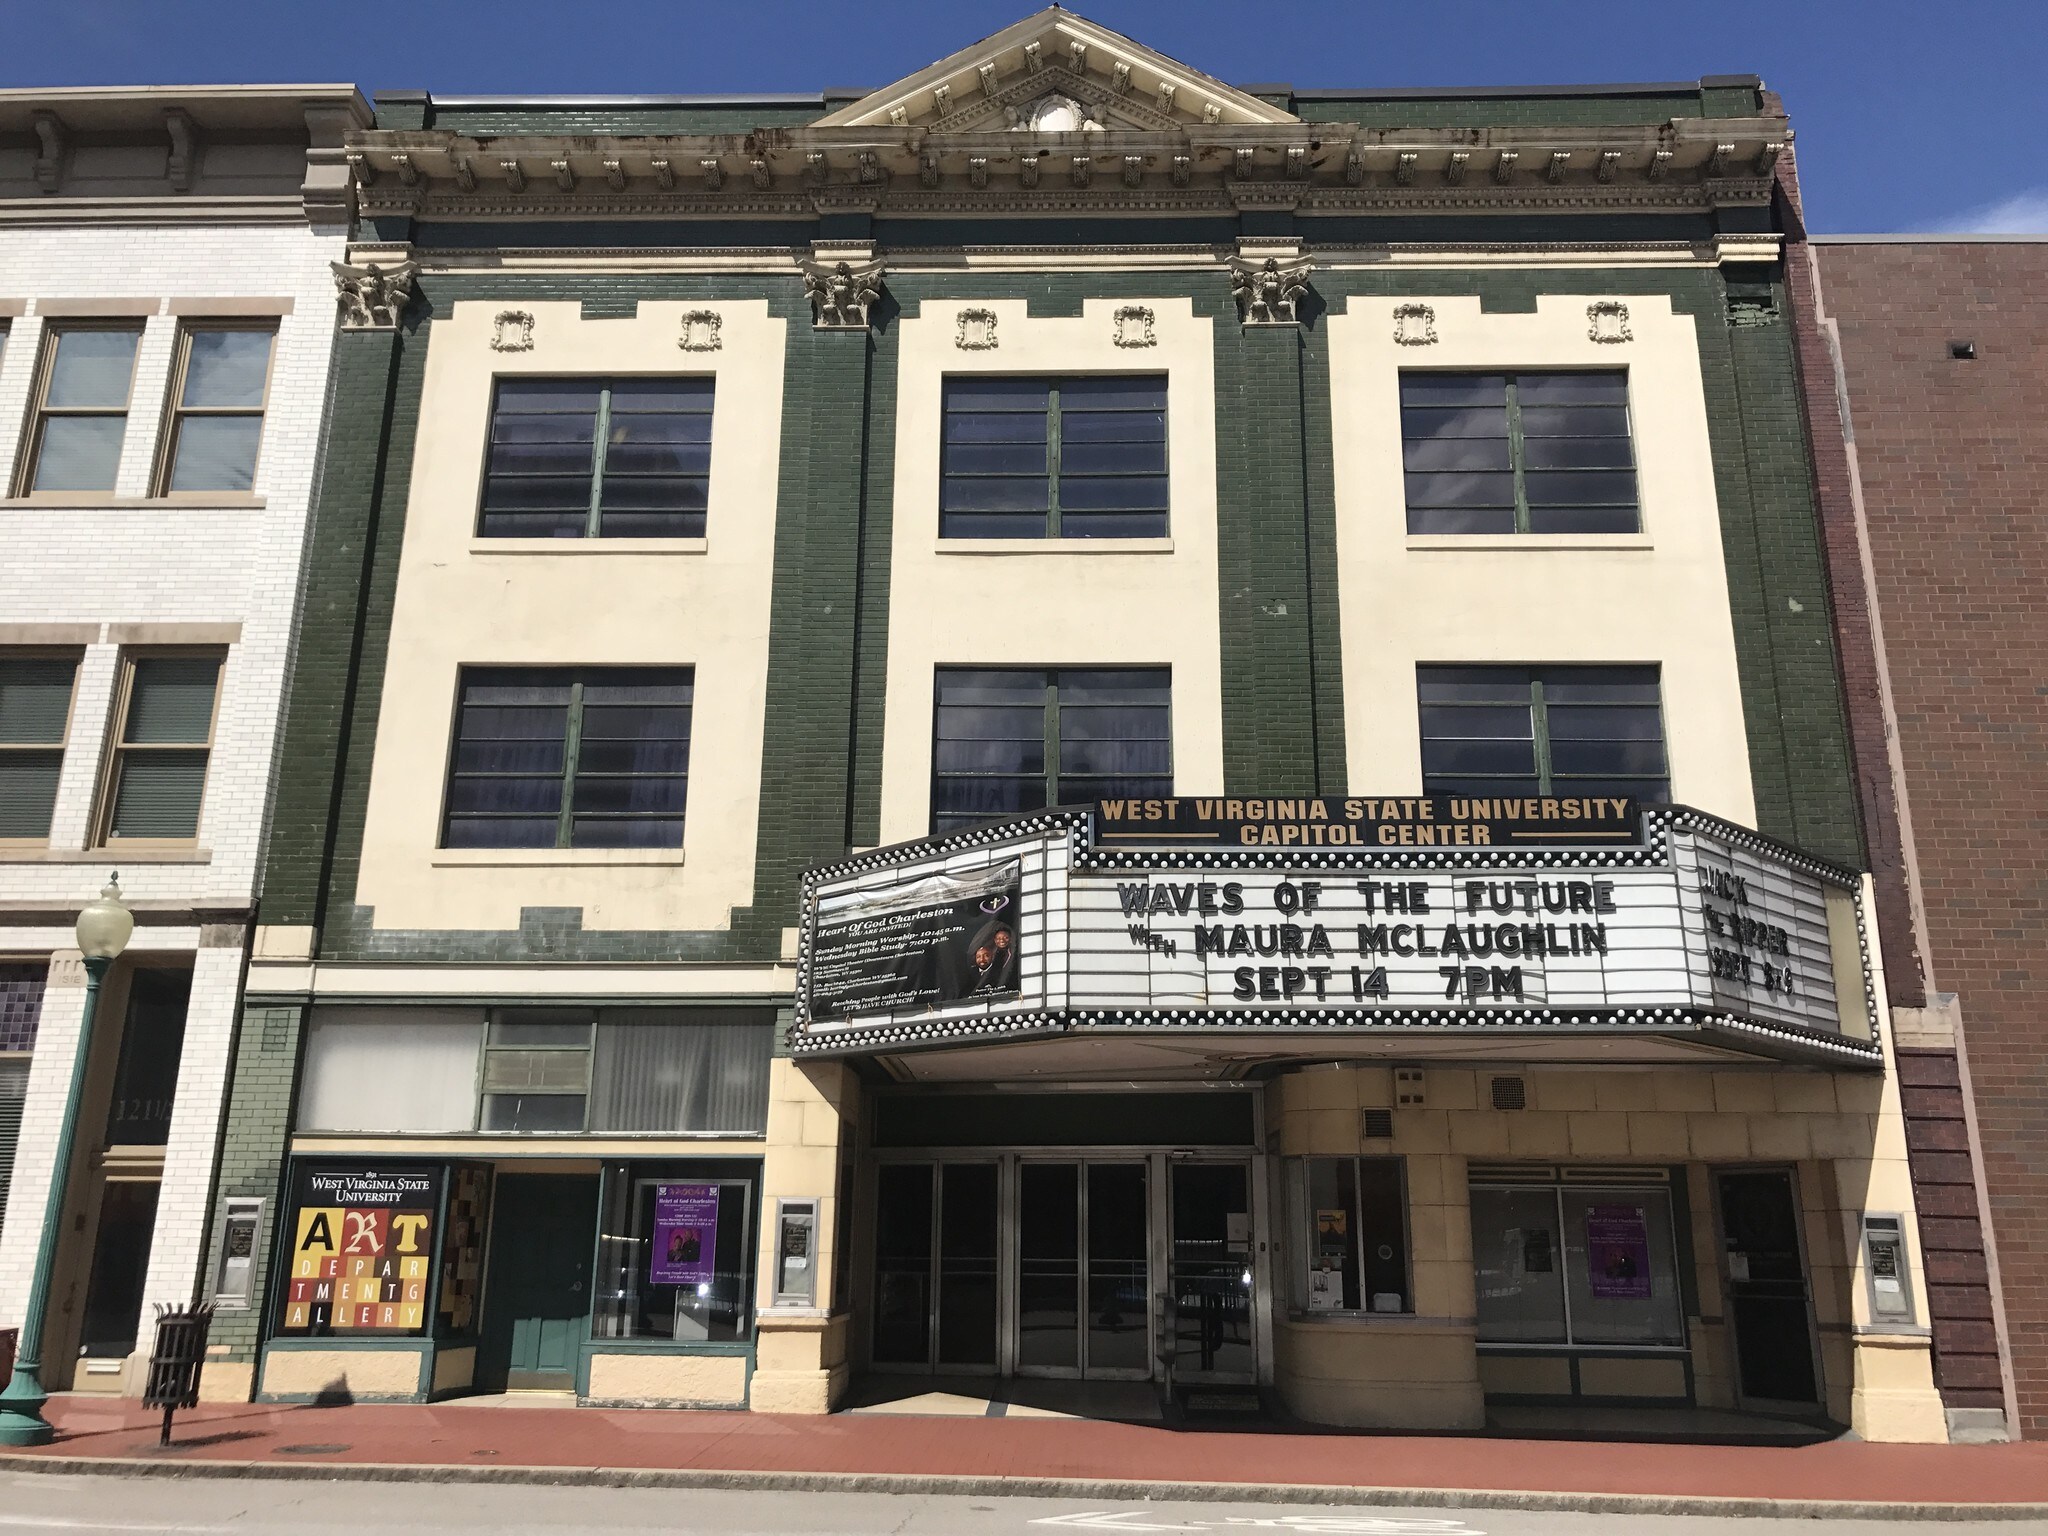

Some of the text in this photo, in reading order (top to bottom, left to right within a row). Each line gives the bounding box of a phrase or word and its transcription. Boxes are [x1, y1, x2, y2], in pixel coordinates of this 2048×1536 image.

[1101, 798, 1628, 820] WEST VIRGINIA STATE UNIVERSITY
[1240, 824, 1490, 845] CAPITOL CENTER
[1117, 881, 1616, 917] WAVES OF THE FUTURE
[817, 908, 954, 938] Heart Of God Charleston
[848, 930, 863, 938] YOU
[863, 928, 878, 936] ARE
[815, 945, 844, 956] Sunday
[844, 940, 879, 950] Morning
[815, 951, 857, 962] Wednesday
[858, 946, 879, 955] Bible
[909, 939, 930, 948] 7:00
[1194, 923, 1334, 960] MAURA
[1357, 922, 1608, 960] MCLAUGHLIN
[1233, 965, 1523, 1001] SEPT 14 7PM
[861, 996, 880, 1004] People
[898, 989, 917, 998] God's
[861, 1001, 880, 1009] HAVE
[300, 1211, 428, 1253] ART
